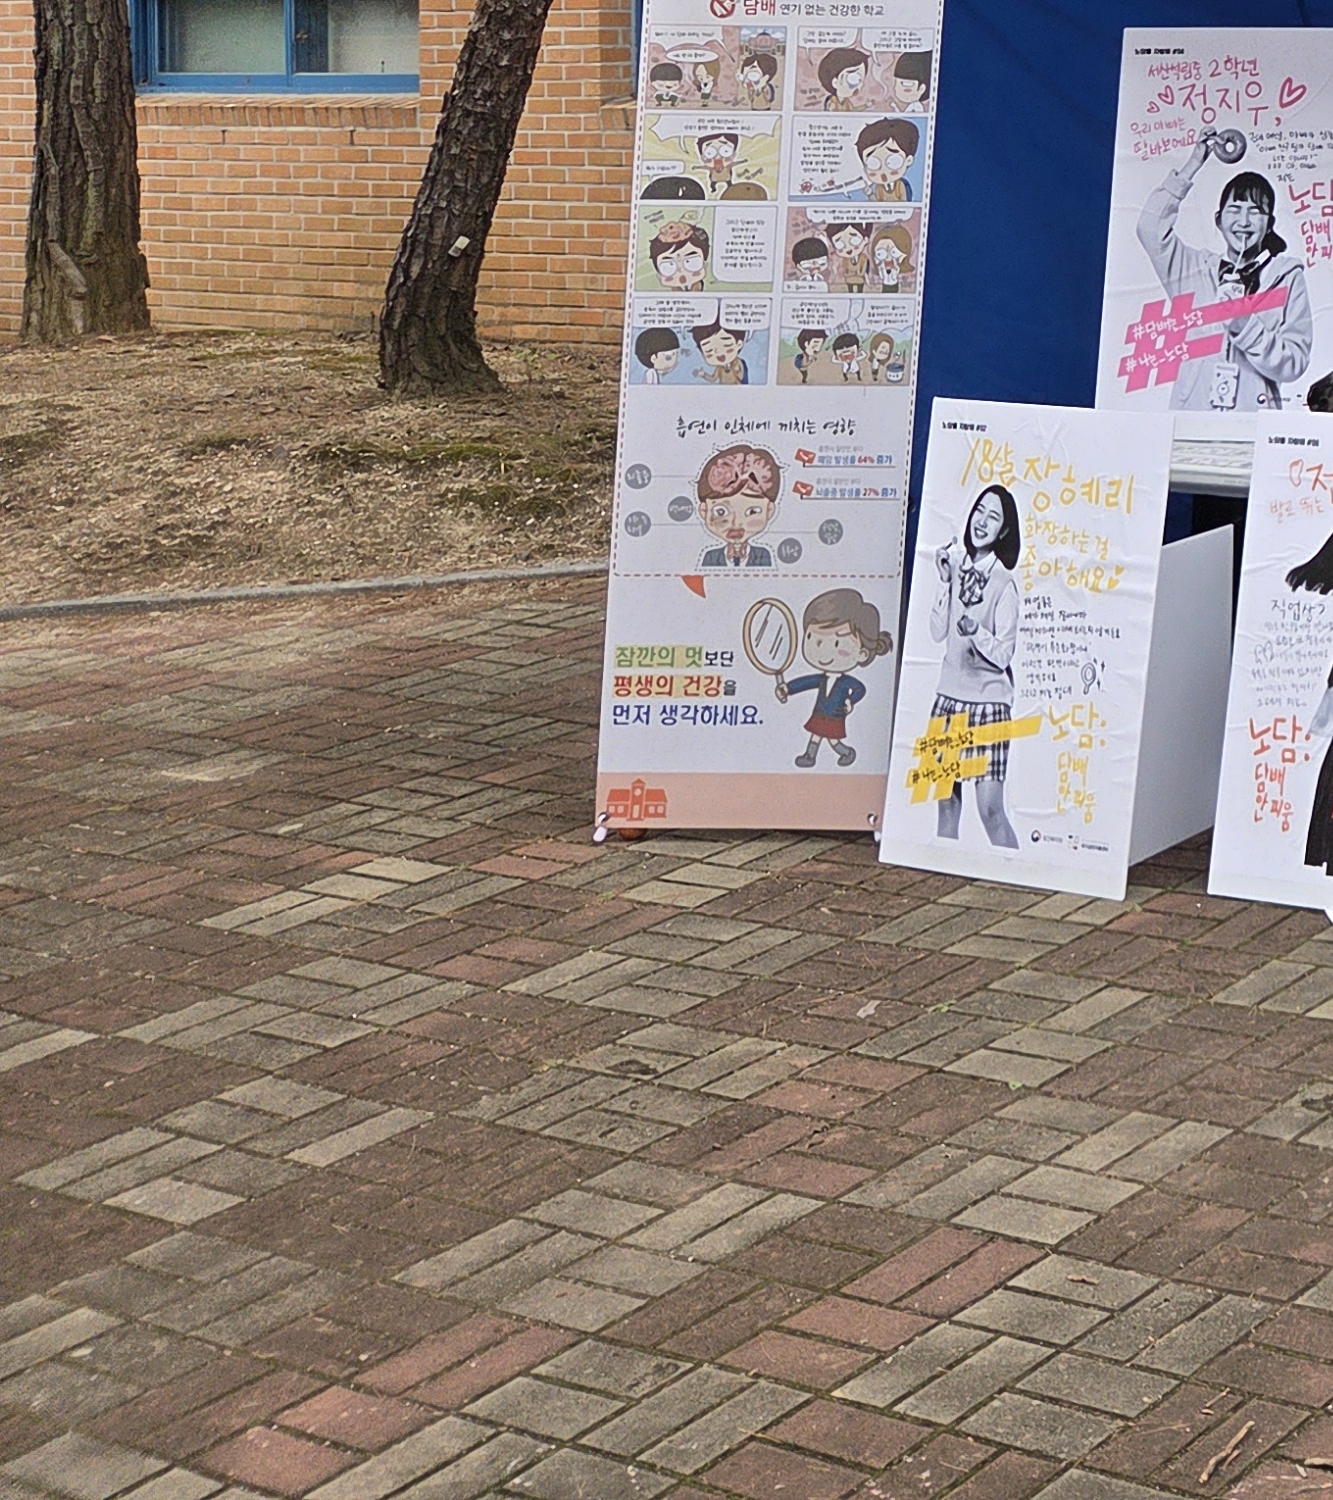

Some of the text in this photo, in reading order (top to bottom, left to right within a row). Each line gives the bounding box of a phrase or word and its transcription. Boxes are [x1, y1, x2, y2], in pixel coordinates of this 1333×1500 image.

[779, 4, 801, 16] 연기
[804, 4, 826, 16] 없는
[829, 4, 861, 16] 건강한
[863, 4, 885, 17] 학교
[1301, 219, 1331, 245] 담배
[675, 415, 717, 438] 흡연이
[724, 416, 771, 436] 인체에
[822, 417, 857, 436] 영향
[615, 646, 734, 668] 잠깐의 멋보단
[614, 675, 737, 697] 평생의 건강을
[613, 704, 764, 726] 먼저 생각하세요.
[1057, 750, 1089, 786] 담배
[1254, 762, 1287, 796] 담배
